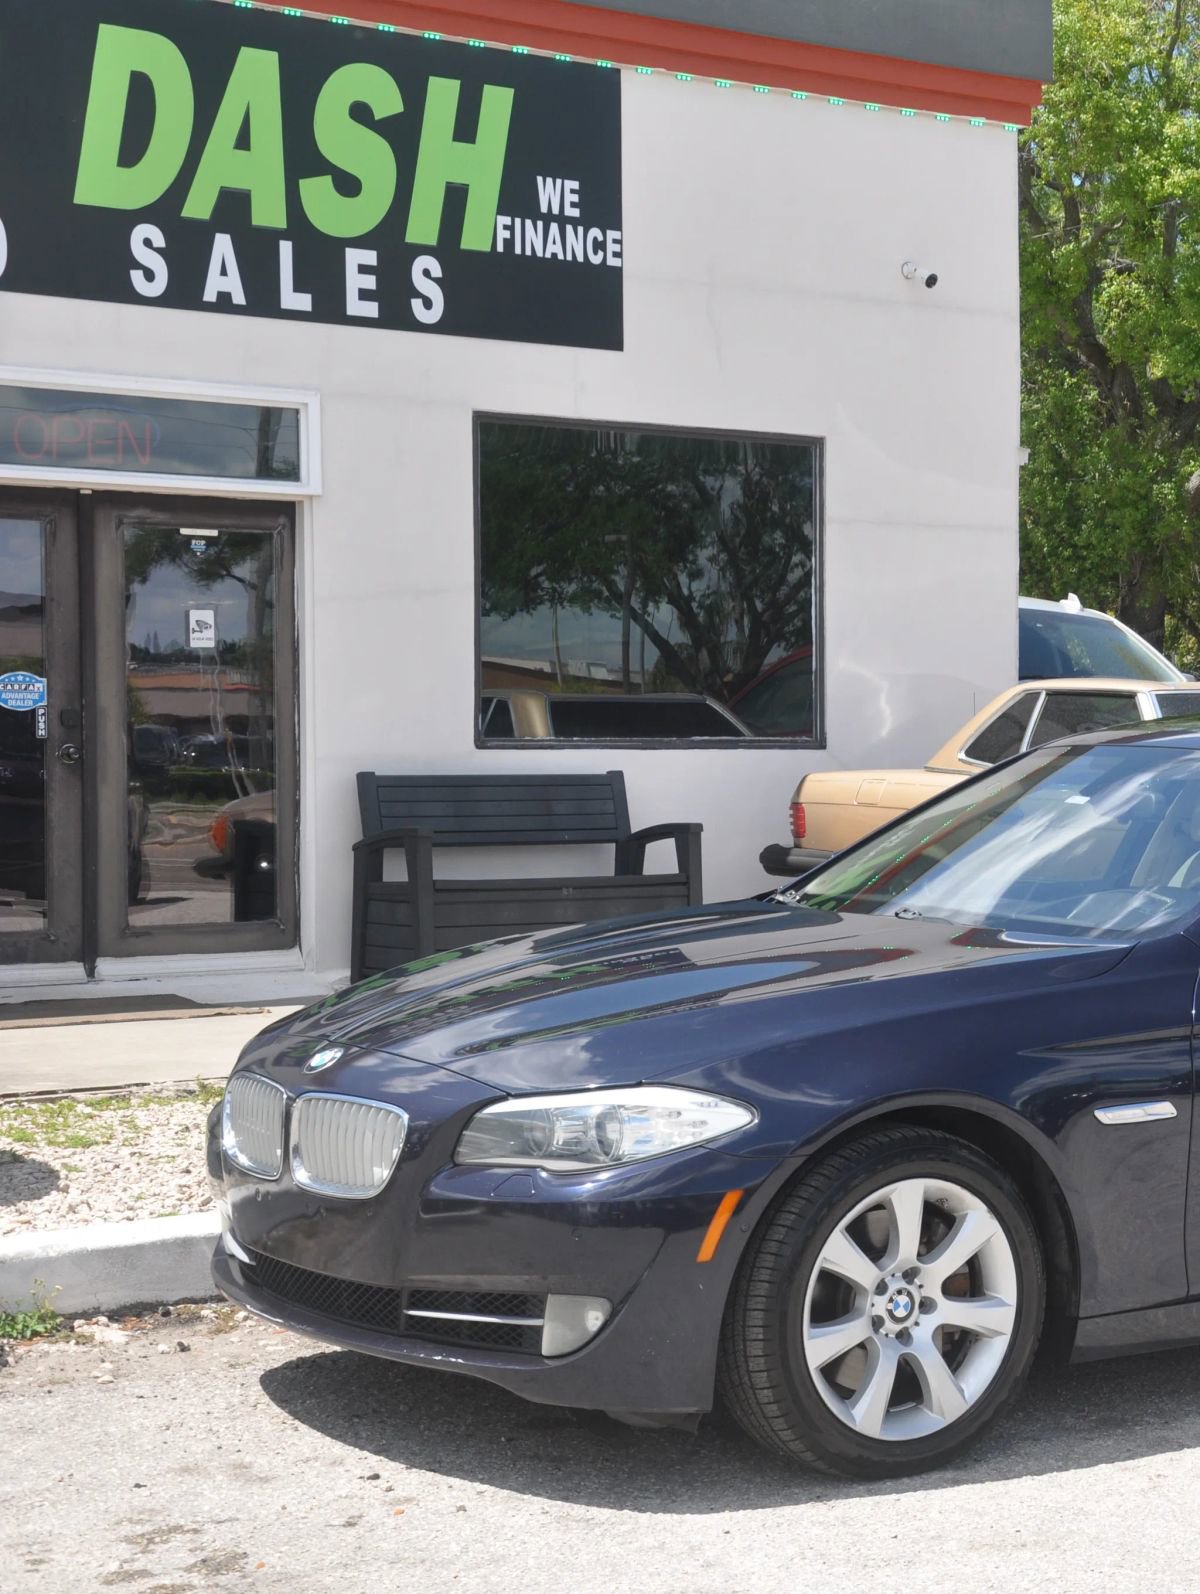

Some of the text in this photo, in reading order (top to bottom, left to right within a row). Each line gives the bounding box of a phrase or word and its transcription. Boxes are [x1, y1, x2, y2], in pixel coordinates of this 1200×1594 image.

[73, 23, 515, 252] DASH
[536, 175, 580, 218] WE
[496, 214, 622, 267] FINANCE
[129, 223, 445, 324] SALES
[13, 413, 154, 465] OPEN
[1, 692, 40, 700] ADVANTAGE
